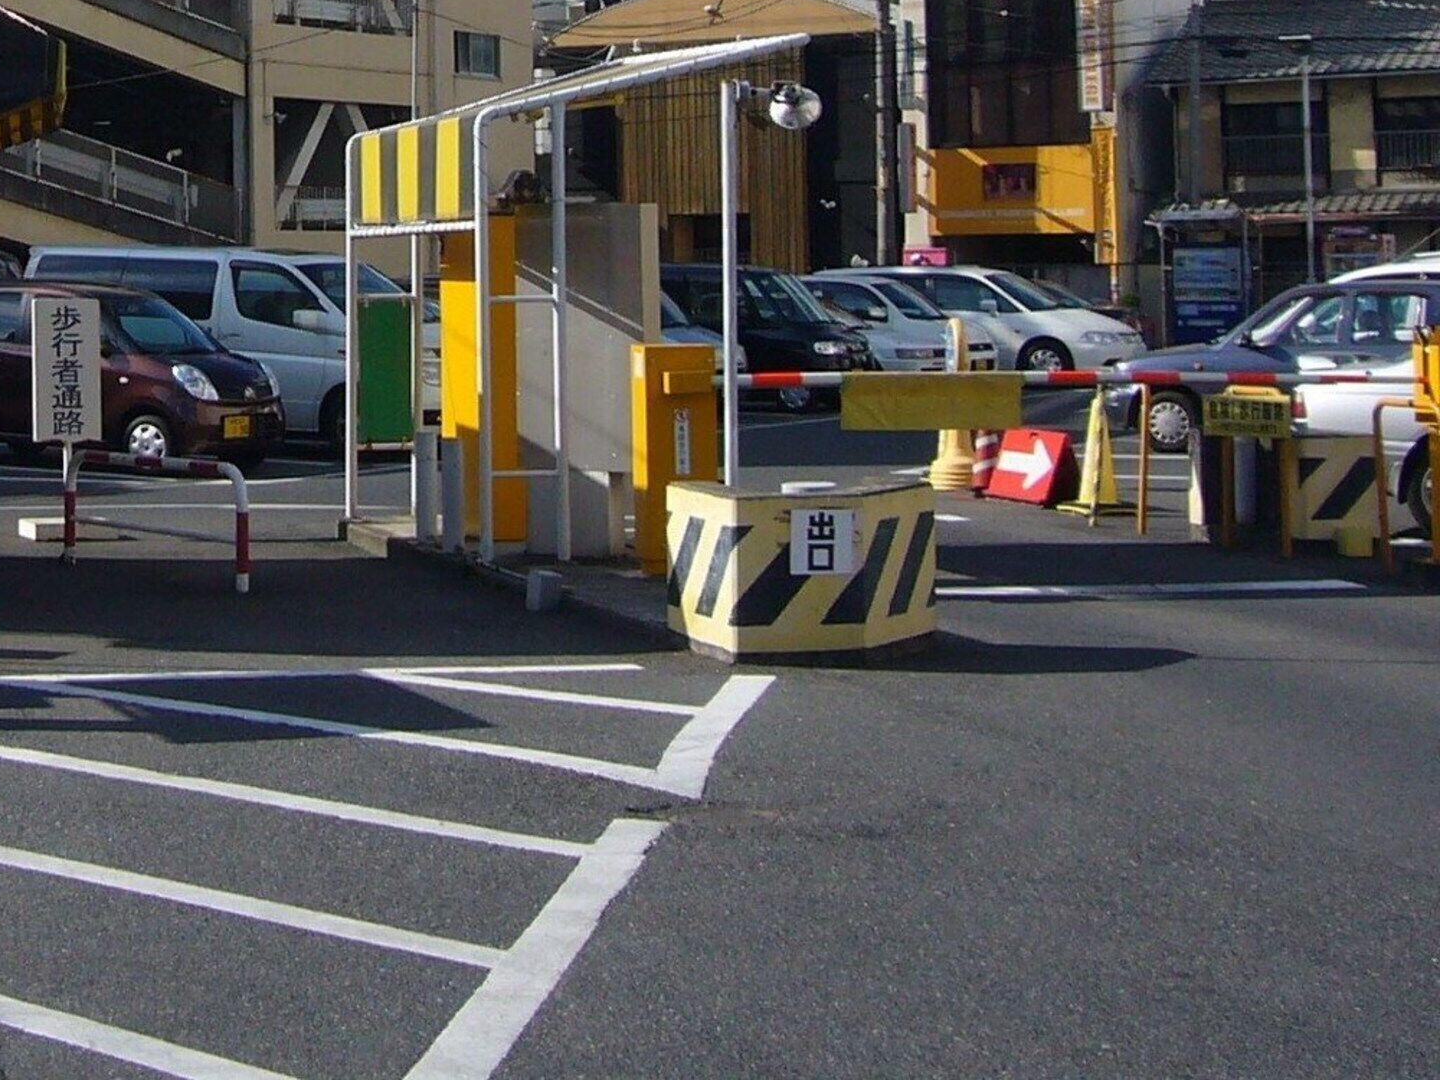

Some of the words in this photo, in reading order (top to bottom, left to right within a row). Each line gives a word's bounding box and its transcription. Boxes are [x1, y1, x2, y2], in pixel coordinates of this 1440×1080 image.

[51, 304, 83, 436] 歩行者通路
[807, 511, 835, 571] 出口
